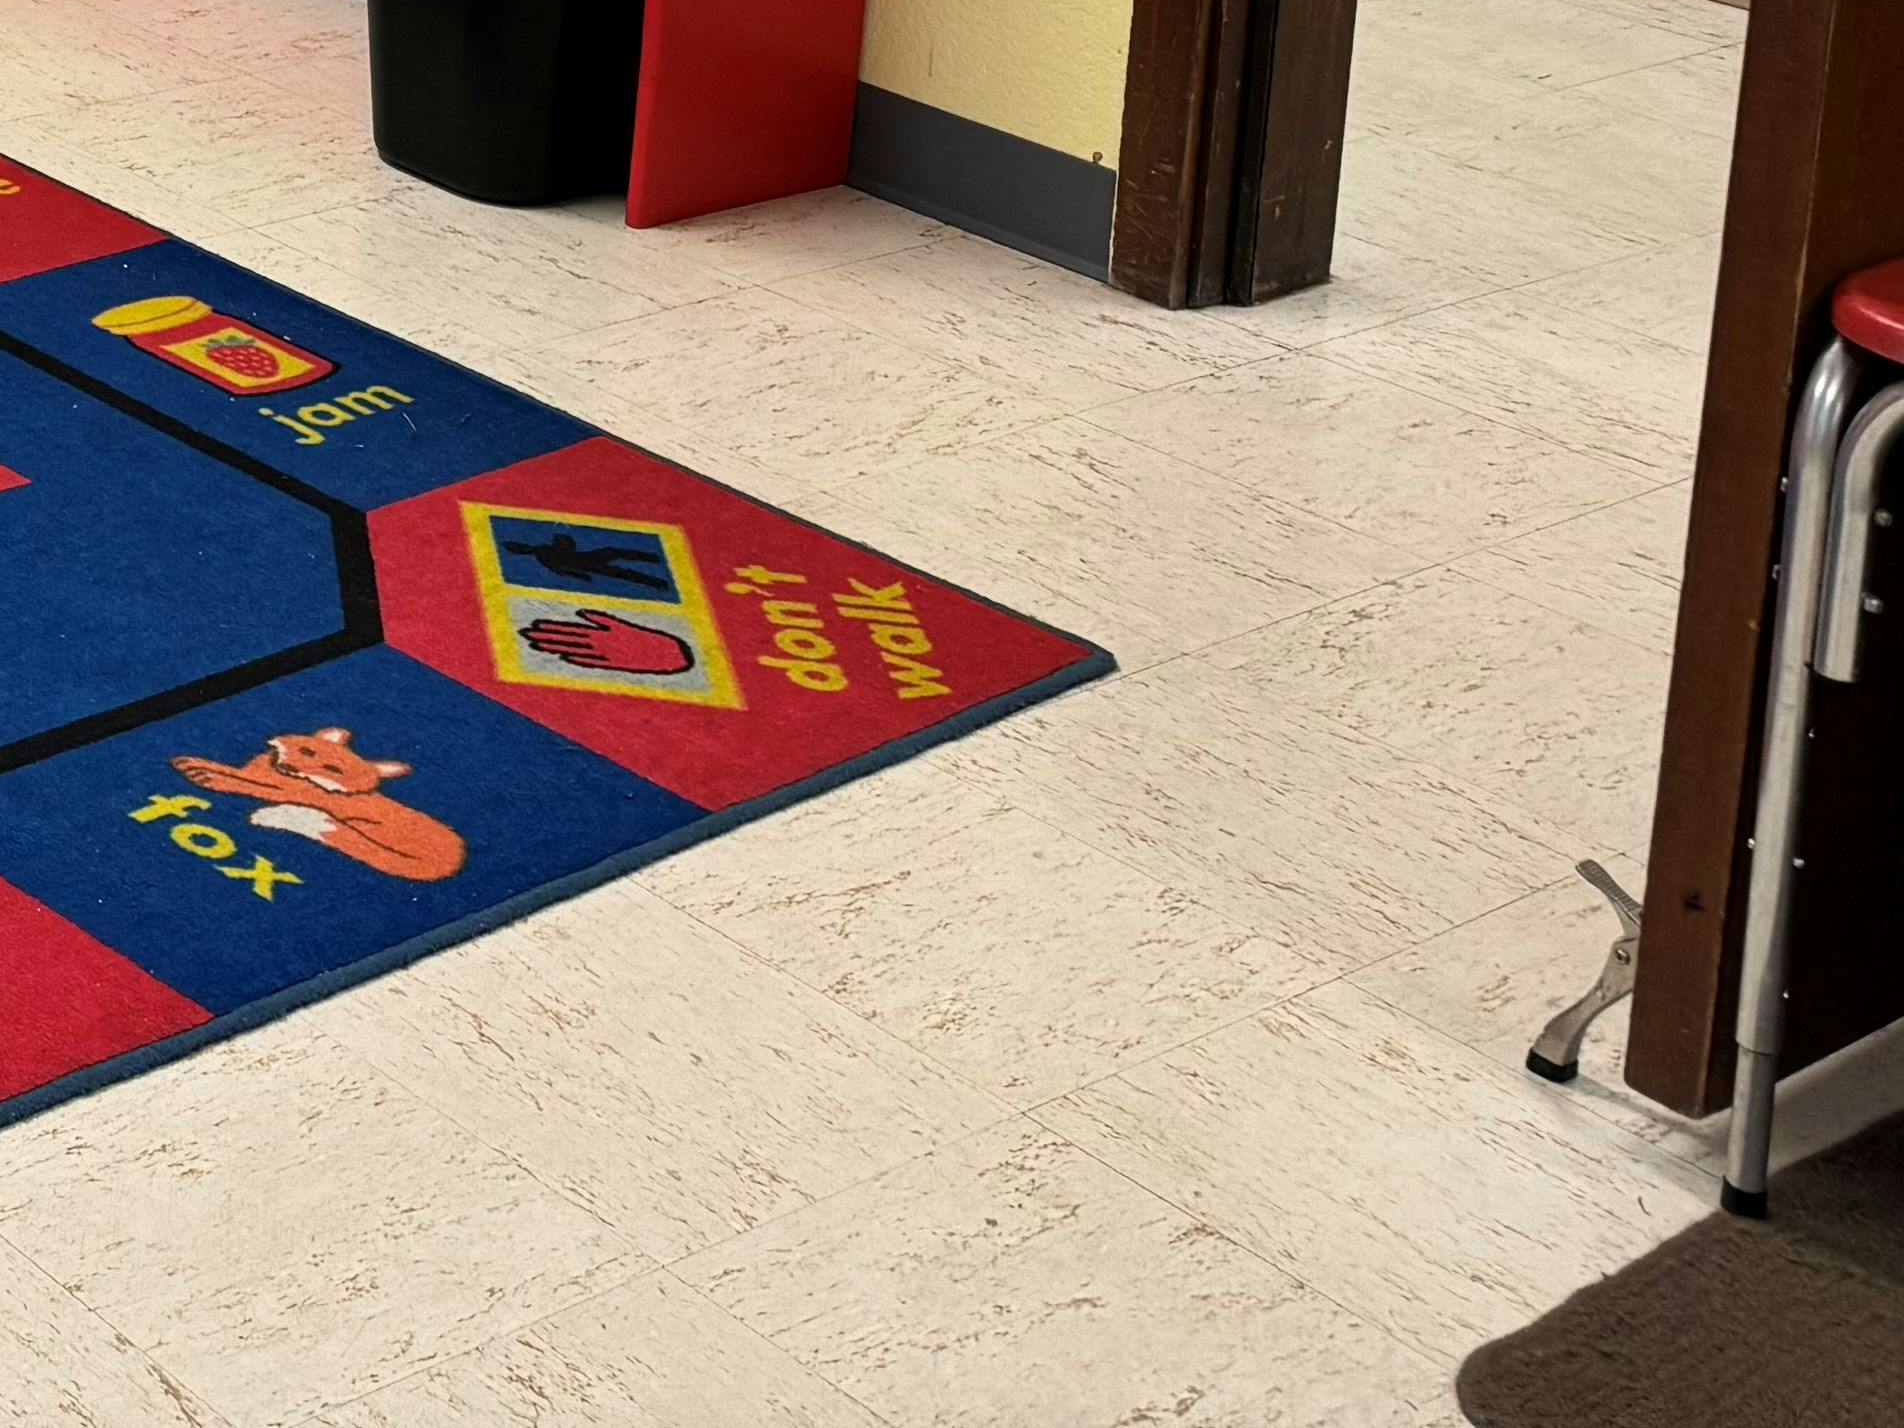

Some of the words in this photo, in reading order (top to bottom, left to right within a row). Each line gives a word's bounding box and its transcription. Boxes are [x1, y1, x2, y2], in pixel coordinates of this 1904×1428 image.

[257, 383, 410, 444] jam
[725, 563, 848, 694] don't
[852, 577, 956, 700] walk
[132, 790, 308, 900] fox
